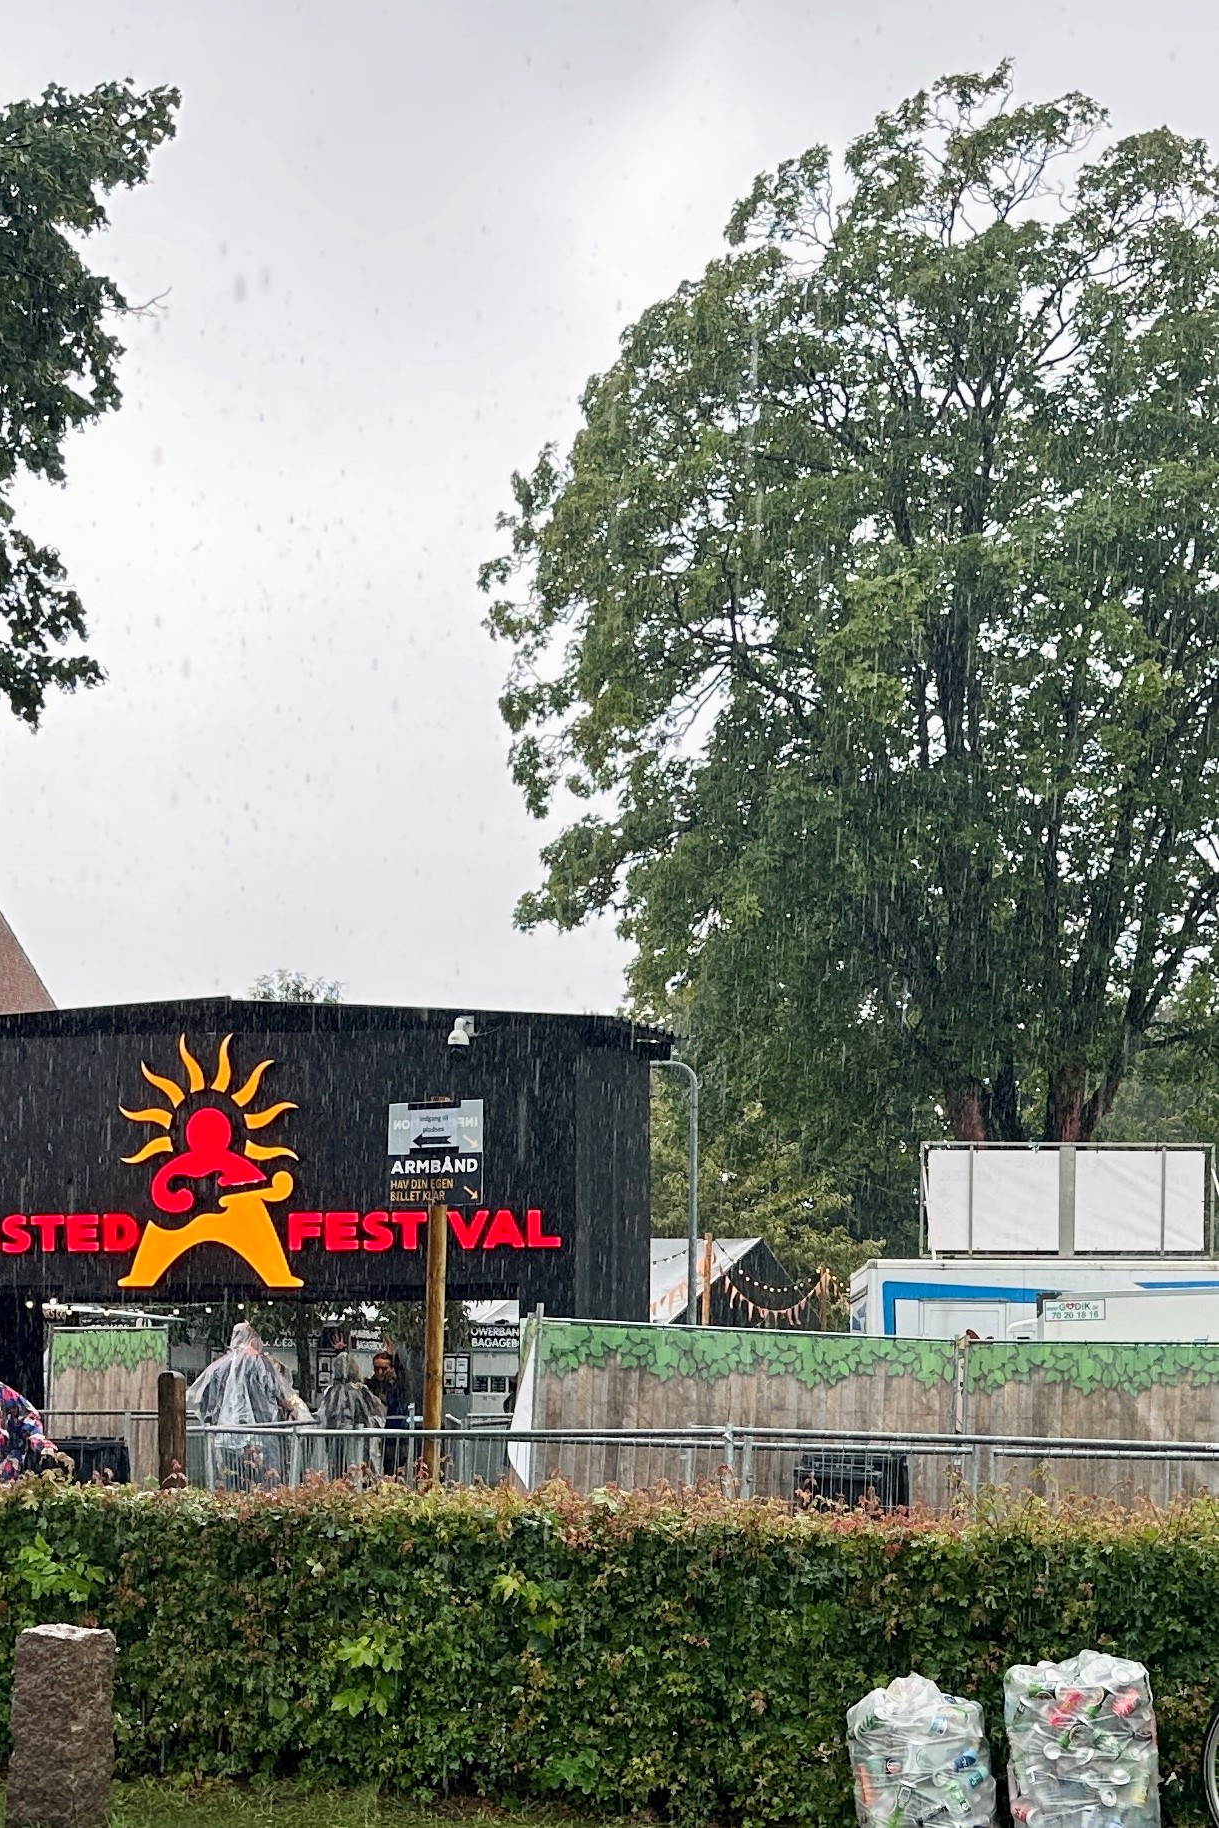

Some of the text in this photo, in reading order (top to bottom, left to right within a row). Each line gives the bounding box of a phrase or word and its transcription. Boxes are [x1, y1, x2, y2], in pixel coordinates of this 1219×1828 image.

[390, 1156, 478, 1175] ARMBÅND
[390, 1178, 453, 1190] HAV DIN EGEN
[390, 1190, 445, 1202] BILLET KLAR
[288, 1210, 561, 1250] FESTVAL
[471, 1338, 519, 1348] BAGAGEB
